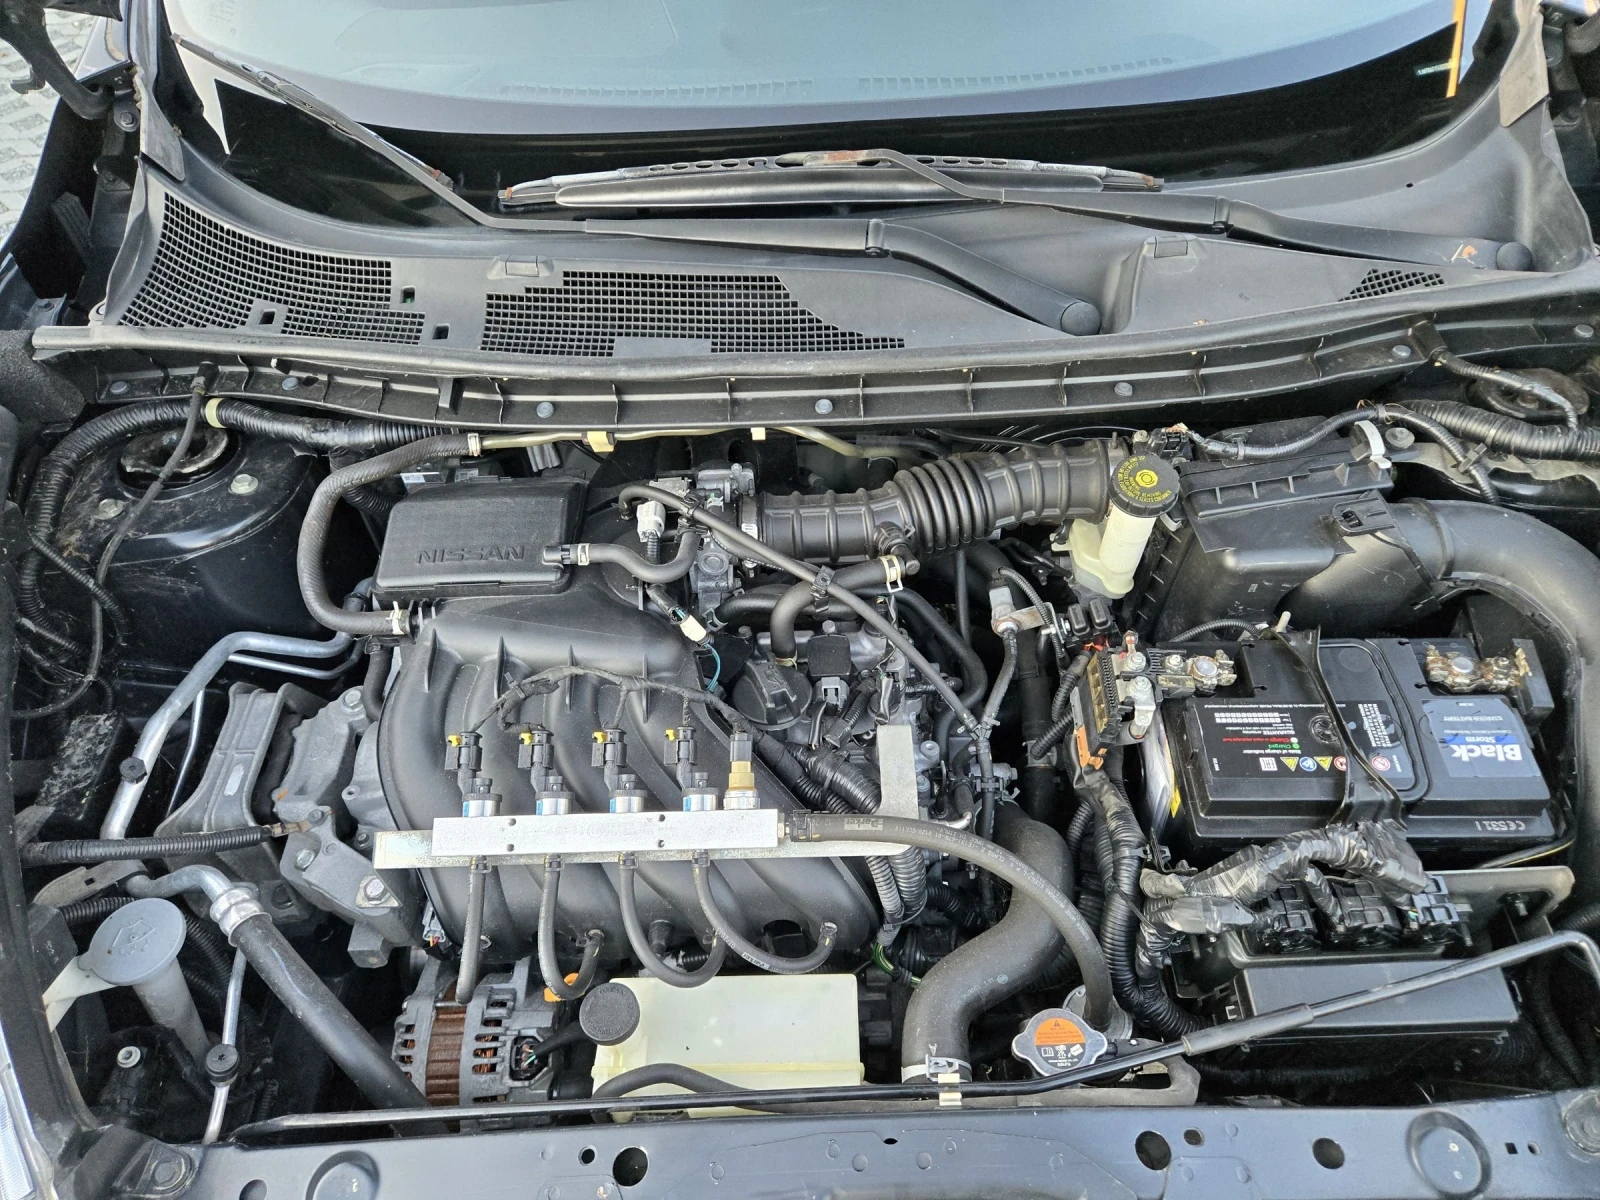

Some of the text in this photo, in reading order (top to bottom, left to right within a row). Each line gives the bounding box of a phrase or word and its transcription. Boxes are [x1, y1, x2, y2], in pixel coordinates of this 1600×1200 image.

[418, 546, 524, 564] NISSAN
[1450, 744, 1522, 762] Black
[845, 818, 878, 828] Parker
